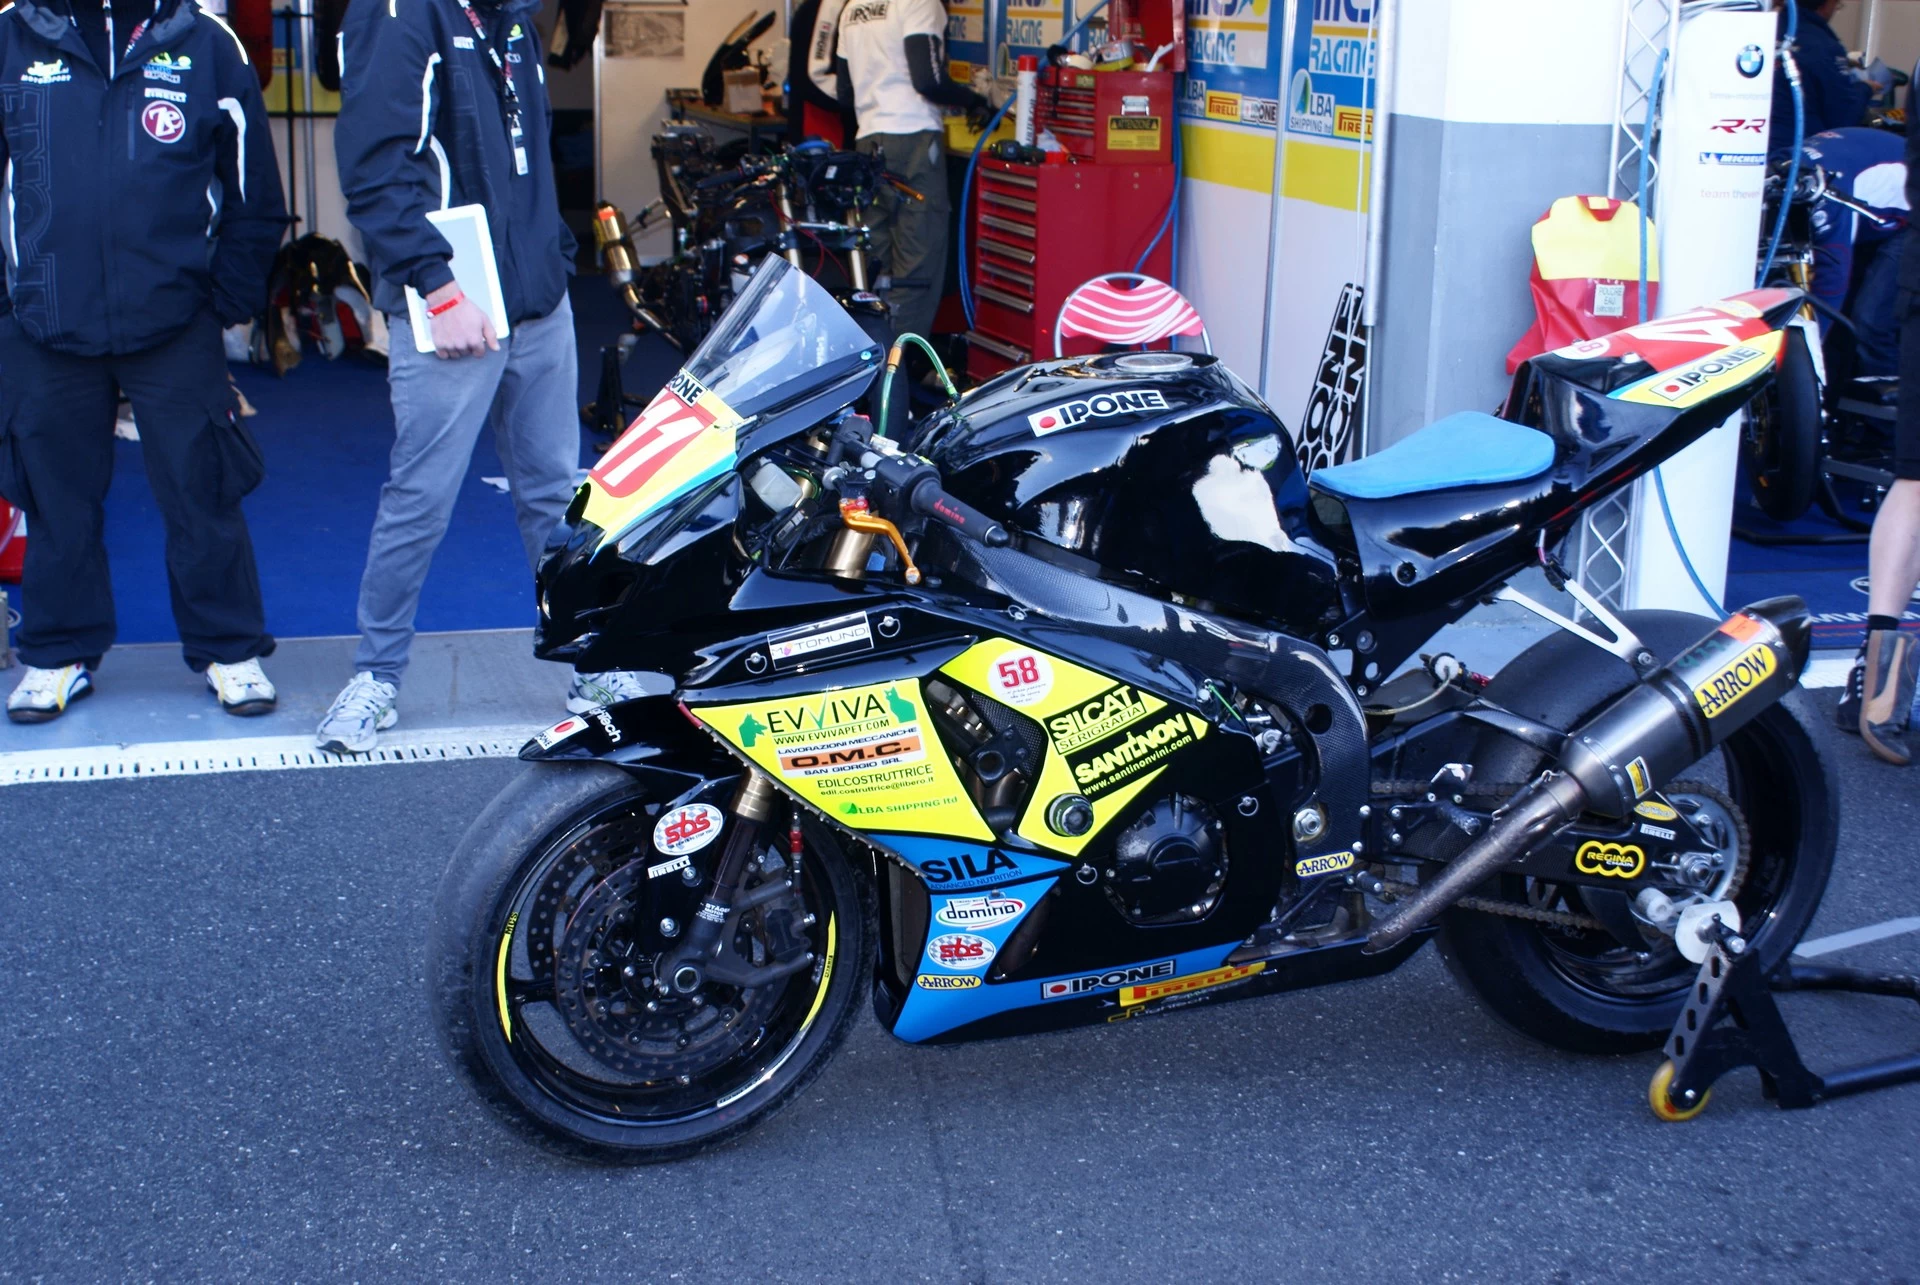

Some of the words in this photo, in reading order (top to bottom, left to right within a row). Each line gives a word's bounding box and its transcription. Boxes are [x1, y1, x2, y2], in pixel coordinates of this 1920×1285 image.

[1007, 19, 1042, 45] RACING
[1209, 96, 1238, 116] PIRELLI
[1290, 116, 1322, 132] SHIPPING
[1680, 346, 1758, 387] IPONE
[1060, 392, 1164, 425] IPONE
[933, 498, 965, 525] domino
[999, 655, 1039, 688] 58
[1702, 648, 1768, 714] ARROW
[767, 684, 886, 734] EVVIVA
[1050, 685, 1131, 740] SILCAT
[773, 718, 890, 745] WWW.EVVIVAPET.COM
[778, 741, 847, 755] LAVORAZIONI
[848, 727, 918, 745] MECCANICHE
[1059, 706, 1142, 750] SERIGRAFIA
[791, 741, 911, 768] O.M.C.
[804, 767, 829, 776] SAN
[831, 761, 878, 773] GIORGIO
[881, 757, 903, 765] SRL
[1082, 735, 1192, 796] www.santinonvini.com
[817, 764, 933, 789] EDILCOSTRUTTRICE
[820, 777, 934, 796] edil.costruttrice@libero.it
[886, 800, 939, 813] SHIPPING
[665, 810, 711, 845] sbs
[1640, 823, 1675, 841] PIRELLI
[648, 855, 692, 879] PIRELLI
[920, 848, 1019, 884] SILA
[1299, 853, 1350, 875] ARROW
[1587, 851, 1633, 863] REGINA
[1606, 860, 1634, 868] CHAIN
[930, 880, 975, 890] ADVANCED
[976, 868, 1023, 885] NUTRITION
[946, 898, 1016, 920] domino
[940, 937, 984, 959] sbs
[920, 976, 977, 988] ARROW
[1072, 960, 1172, 993] IPONE
